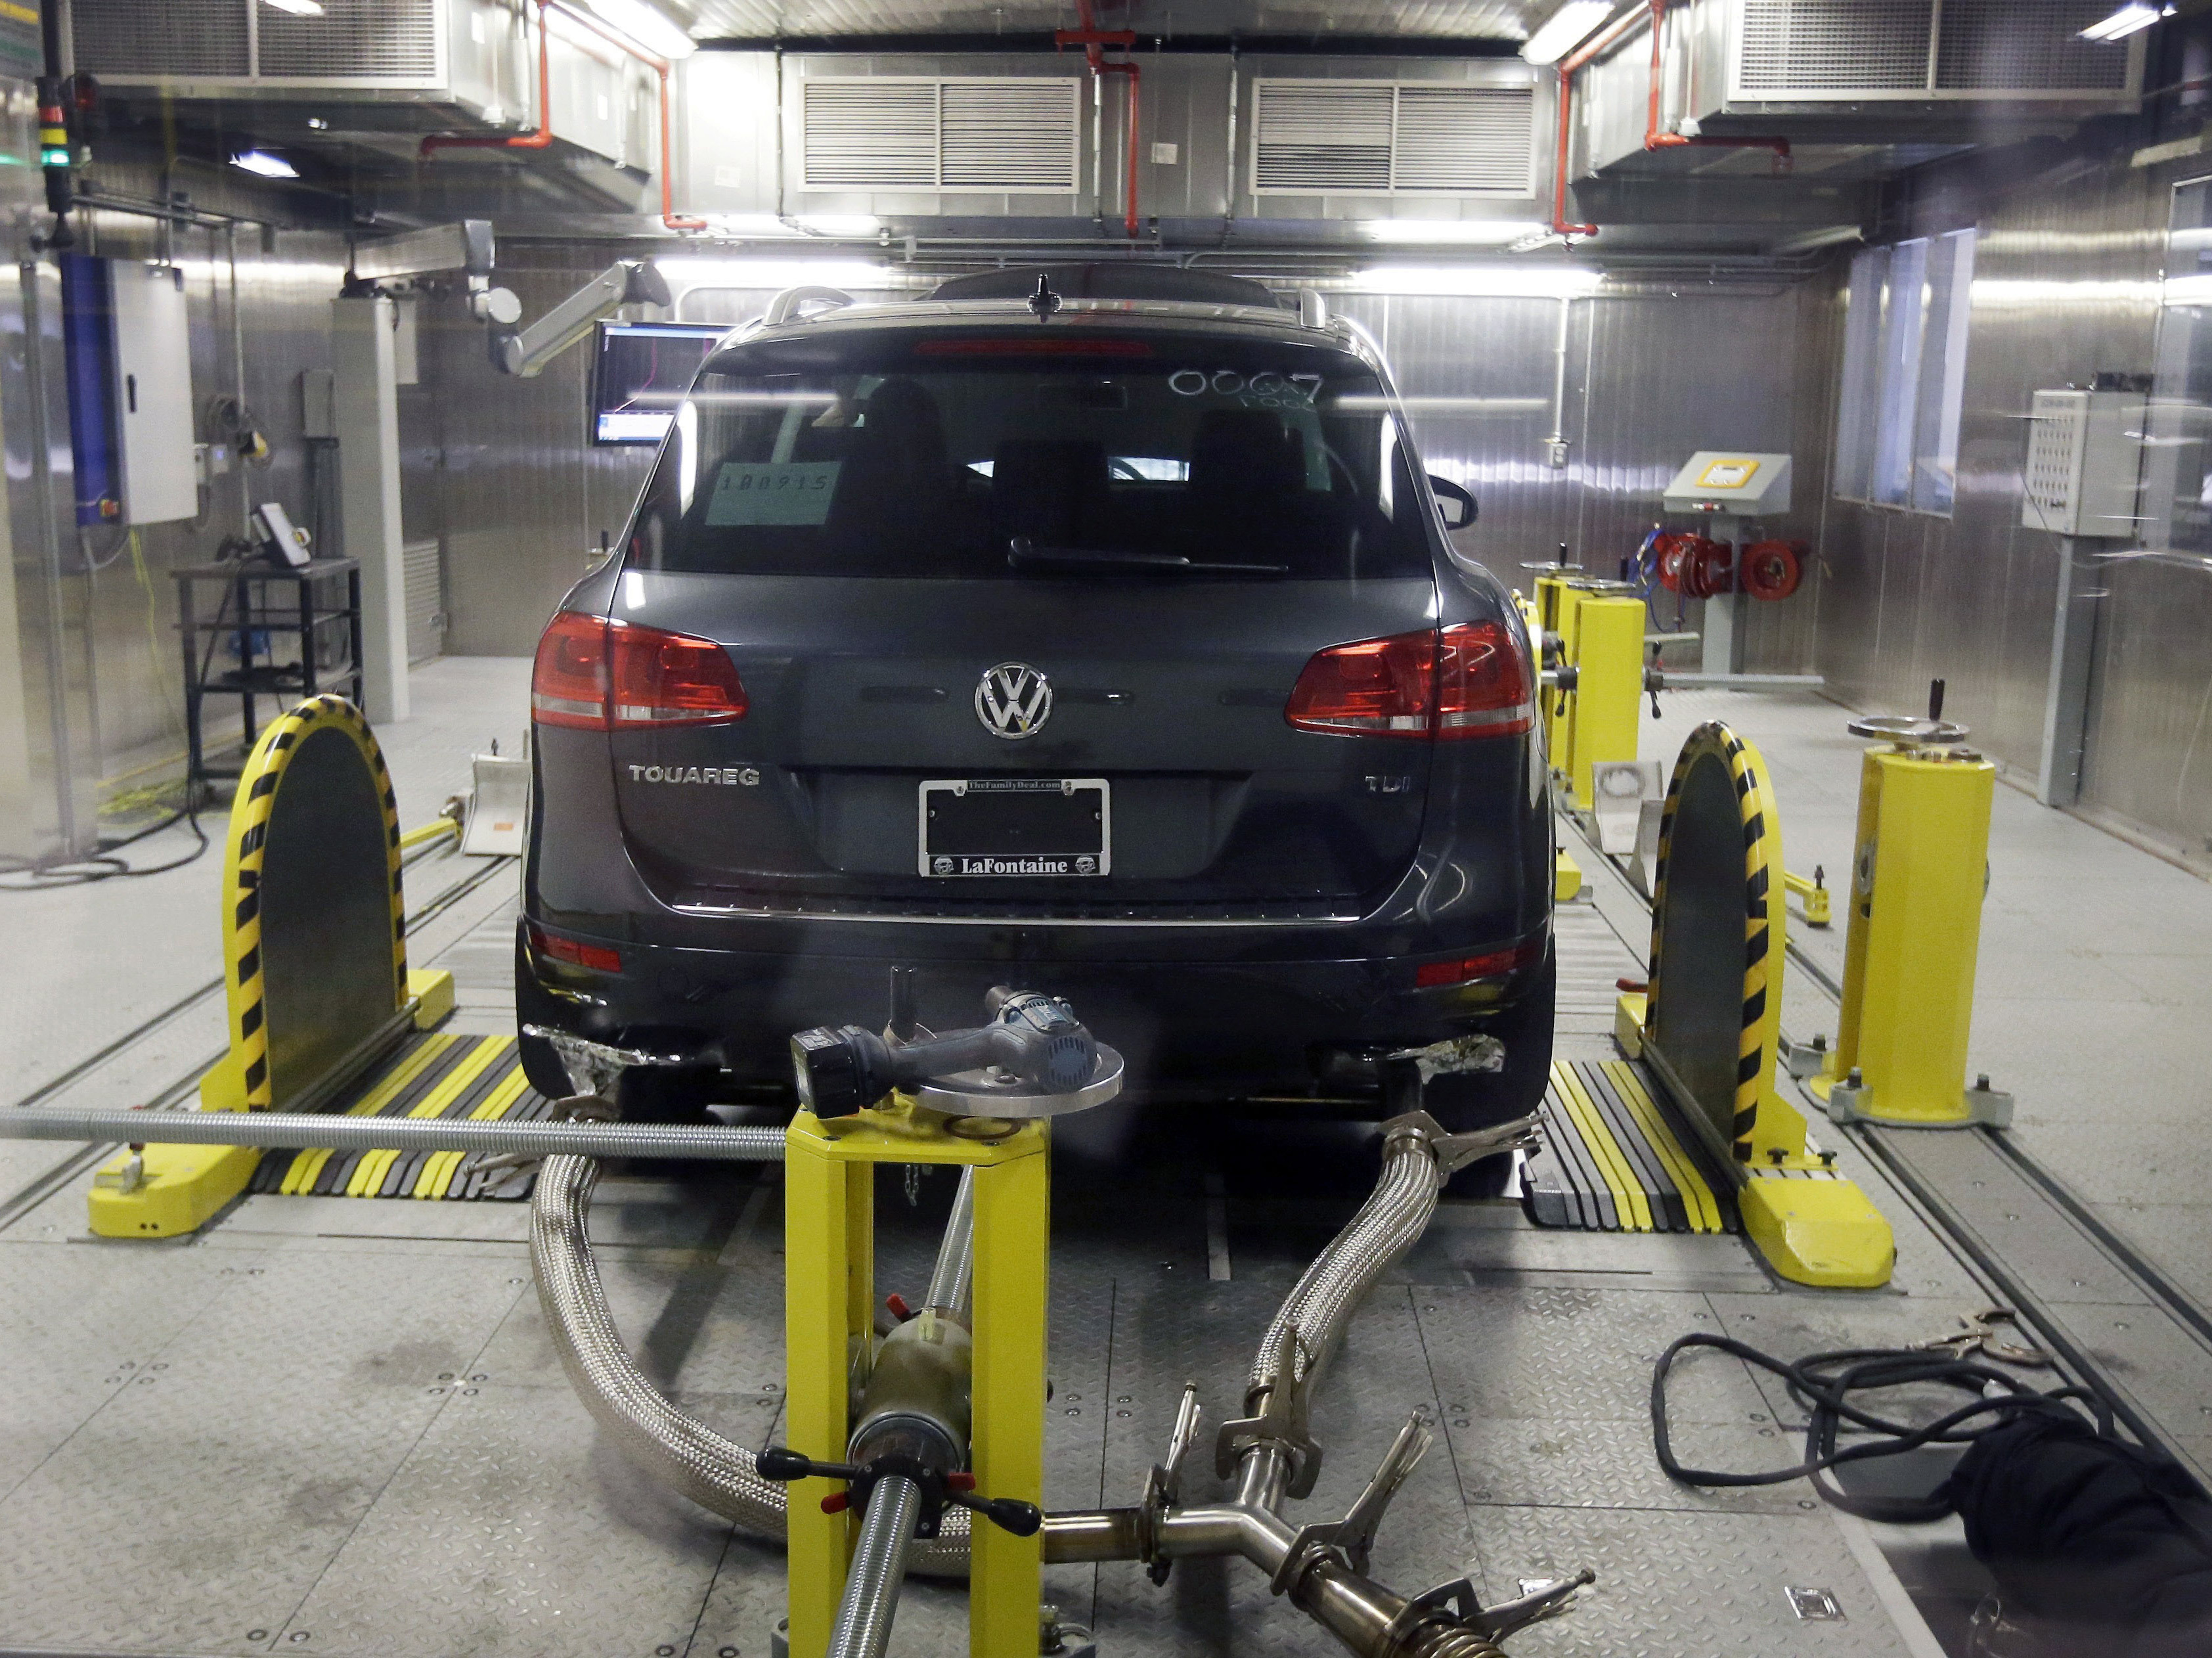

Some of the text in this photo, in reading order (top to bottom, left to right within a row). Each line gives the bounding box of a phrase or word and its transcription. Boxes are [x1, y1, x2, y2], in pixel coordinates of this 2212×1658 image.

[629, 765, 760, 786] TOUAREG
[969, 780, 1061, 790] TheFamilyDeal.com
[1365, 776, 1411, 792] TDI
[961, 857, 1069, 874] LaFontaine
